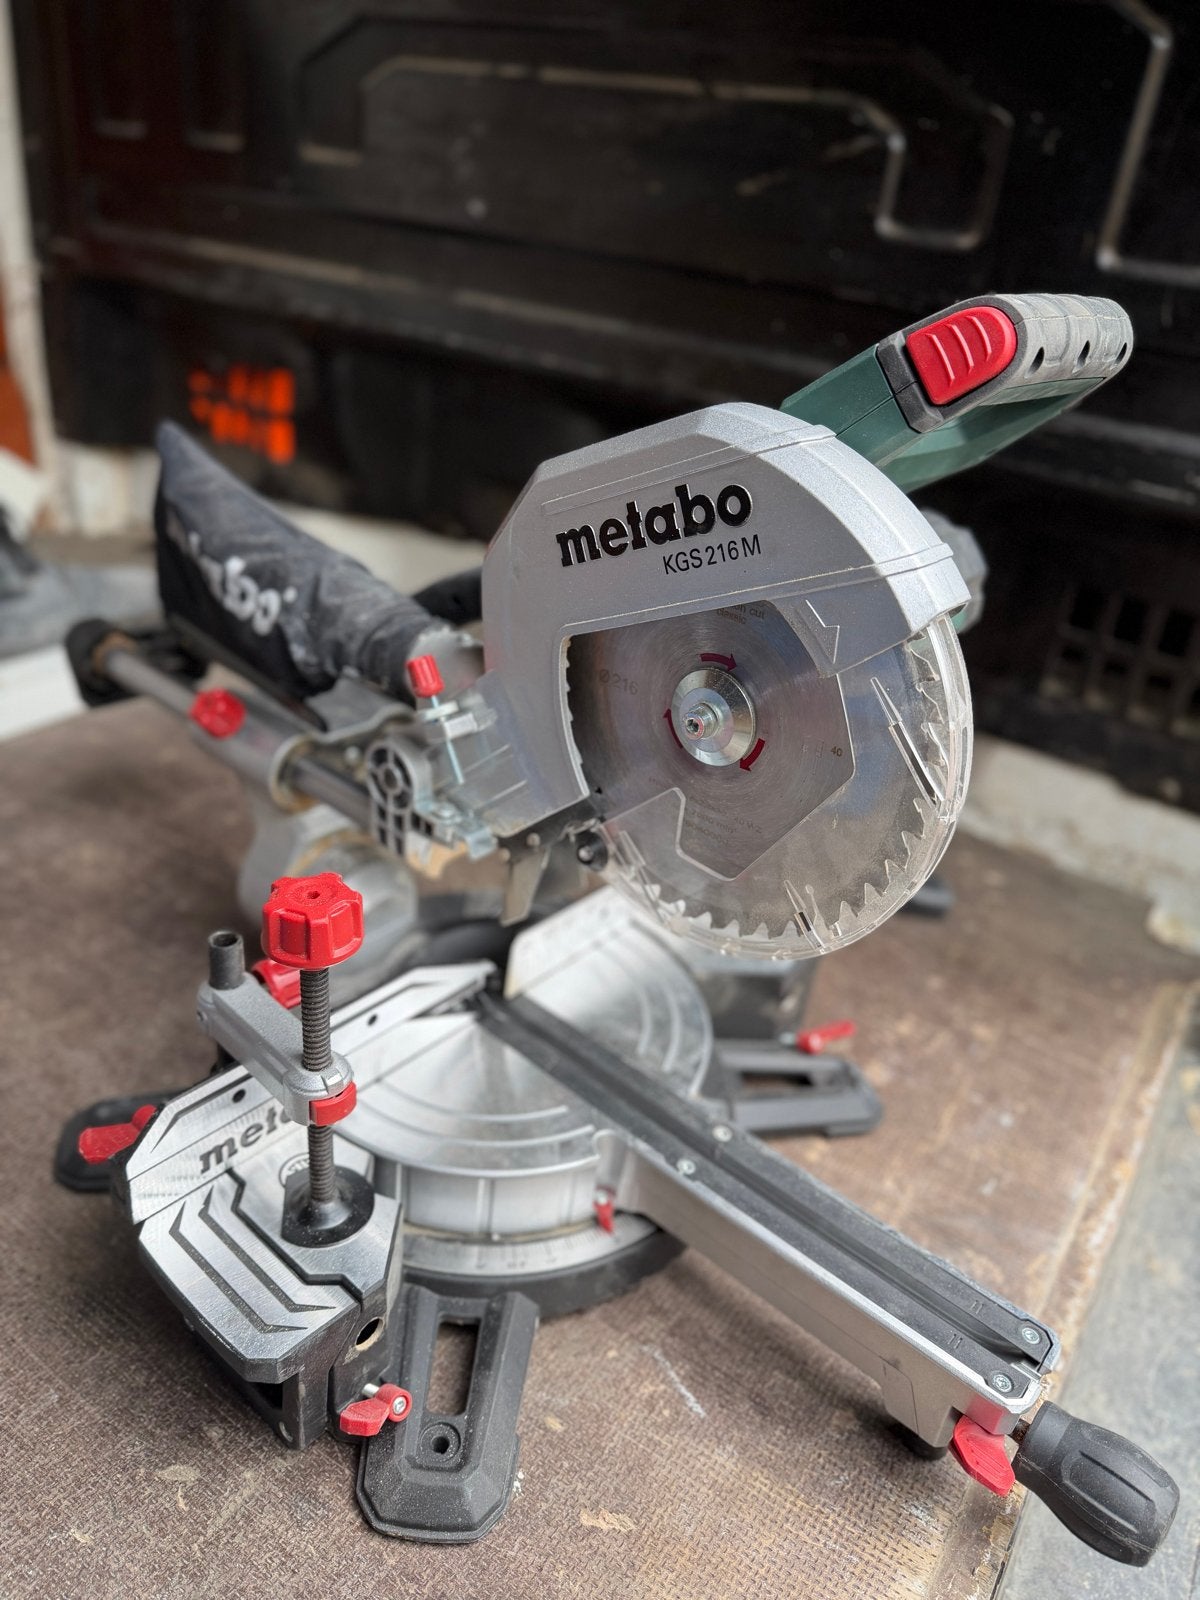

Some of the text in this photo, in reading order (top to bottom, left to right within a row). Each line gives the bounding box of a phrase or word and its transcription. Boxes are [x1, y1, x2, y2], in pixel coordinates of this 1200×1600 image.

[555, 483, 753, 567] metabo
[663, 548, 703, 575] KGS
[830, 745, 844, 758] 40
